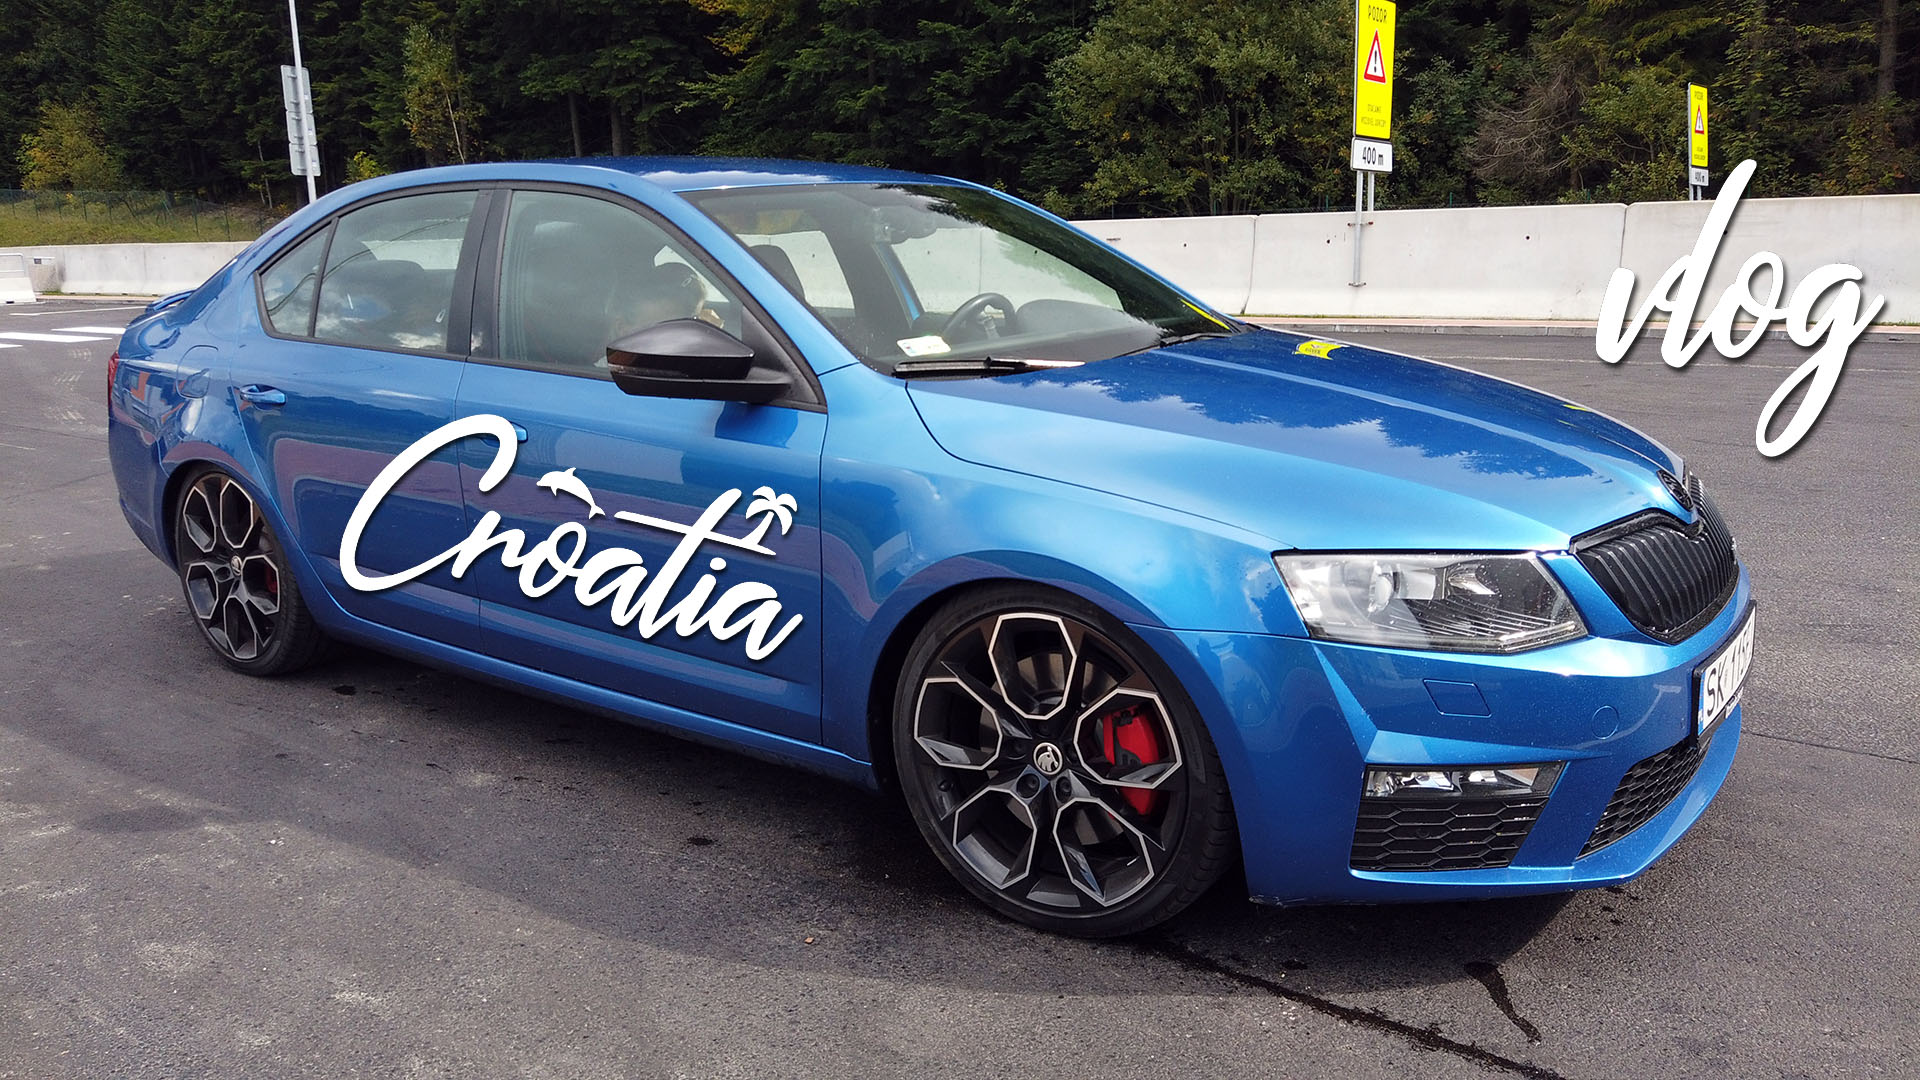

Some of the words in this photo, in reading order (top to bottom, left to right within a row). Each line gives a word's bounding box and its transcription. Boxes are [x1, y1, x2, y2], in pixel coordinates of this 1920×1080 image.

[1367, 4, 1388, 24] POZOR
[1362, 146, 1377, 165] 400
[1377, 153, 1384, 166] m
[1707, 656, 1727, 717] SK
